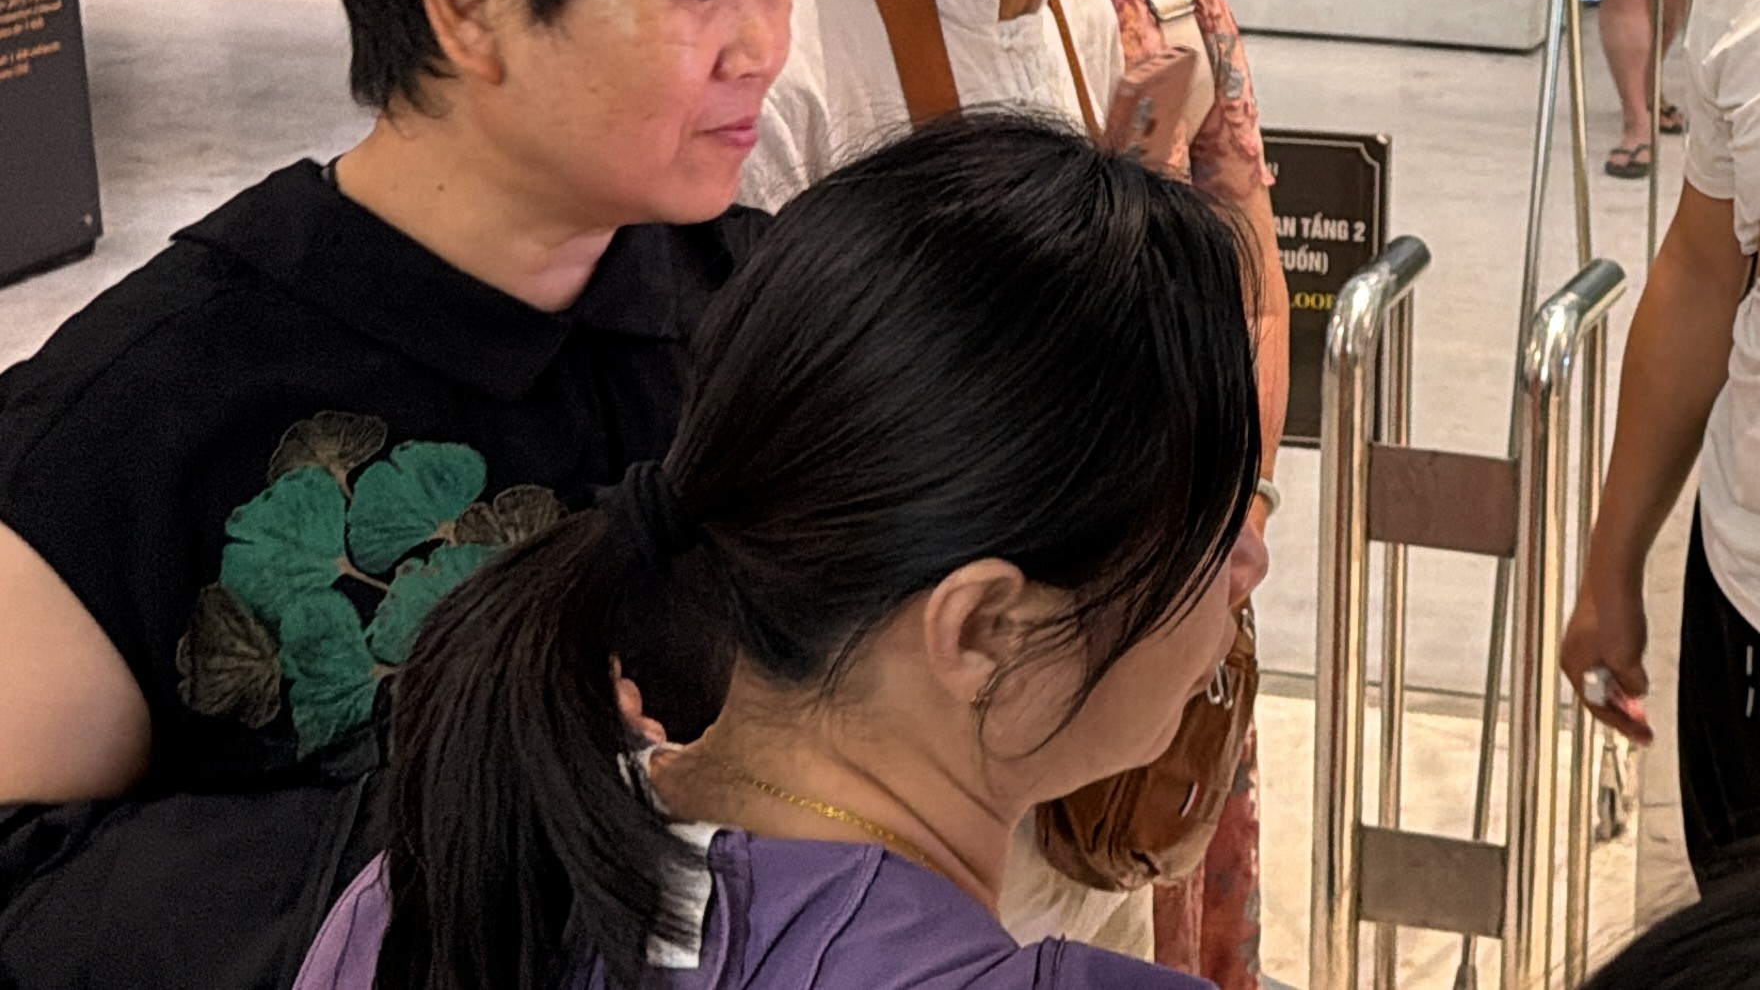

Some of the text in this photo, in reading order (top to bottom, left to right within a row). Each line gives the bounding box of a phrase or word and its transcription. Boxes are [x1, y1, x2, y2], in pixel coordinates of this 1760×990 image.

[1273, 215, 1297, 239] AN
[1353, 220, 1367, 243] 2
[1278, 243, 1329, 276] UỐN)
